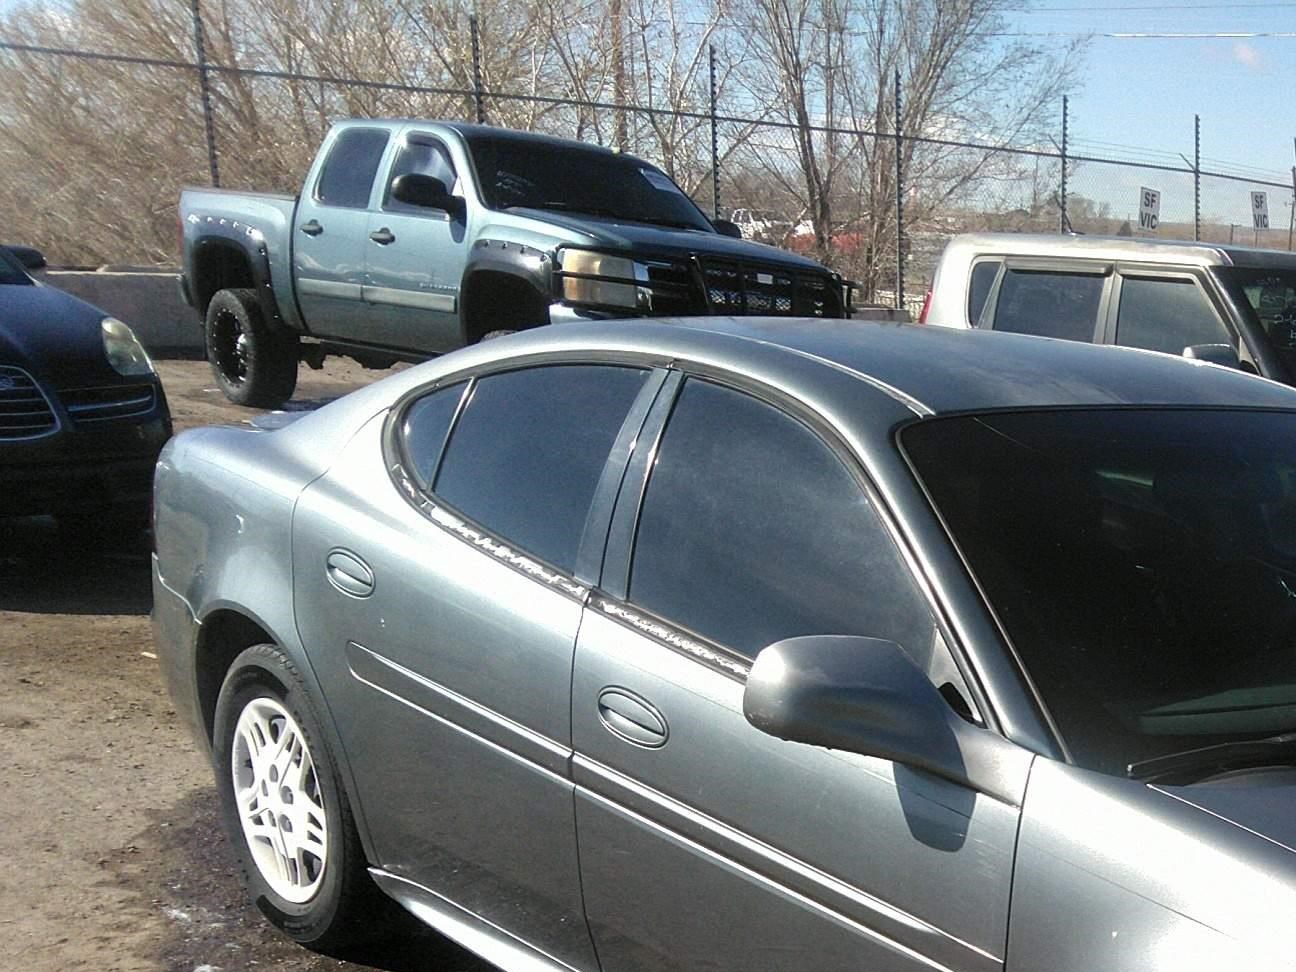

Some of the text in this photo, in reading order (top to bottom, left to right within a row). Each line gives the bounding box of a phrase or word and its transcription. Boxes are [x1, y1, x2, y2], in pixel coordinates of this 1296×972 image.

[1143, 191, 1157, 209] SF
[1254, 194, 1264, 209] SF
[1140, 211, 1157, 230] VIC
[1253, 214, 1268, 229] VIC
